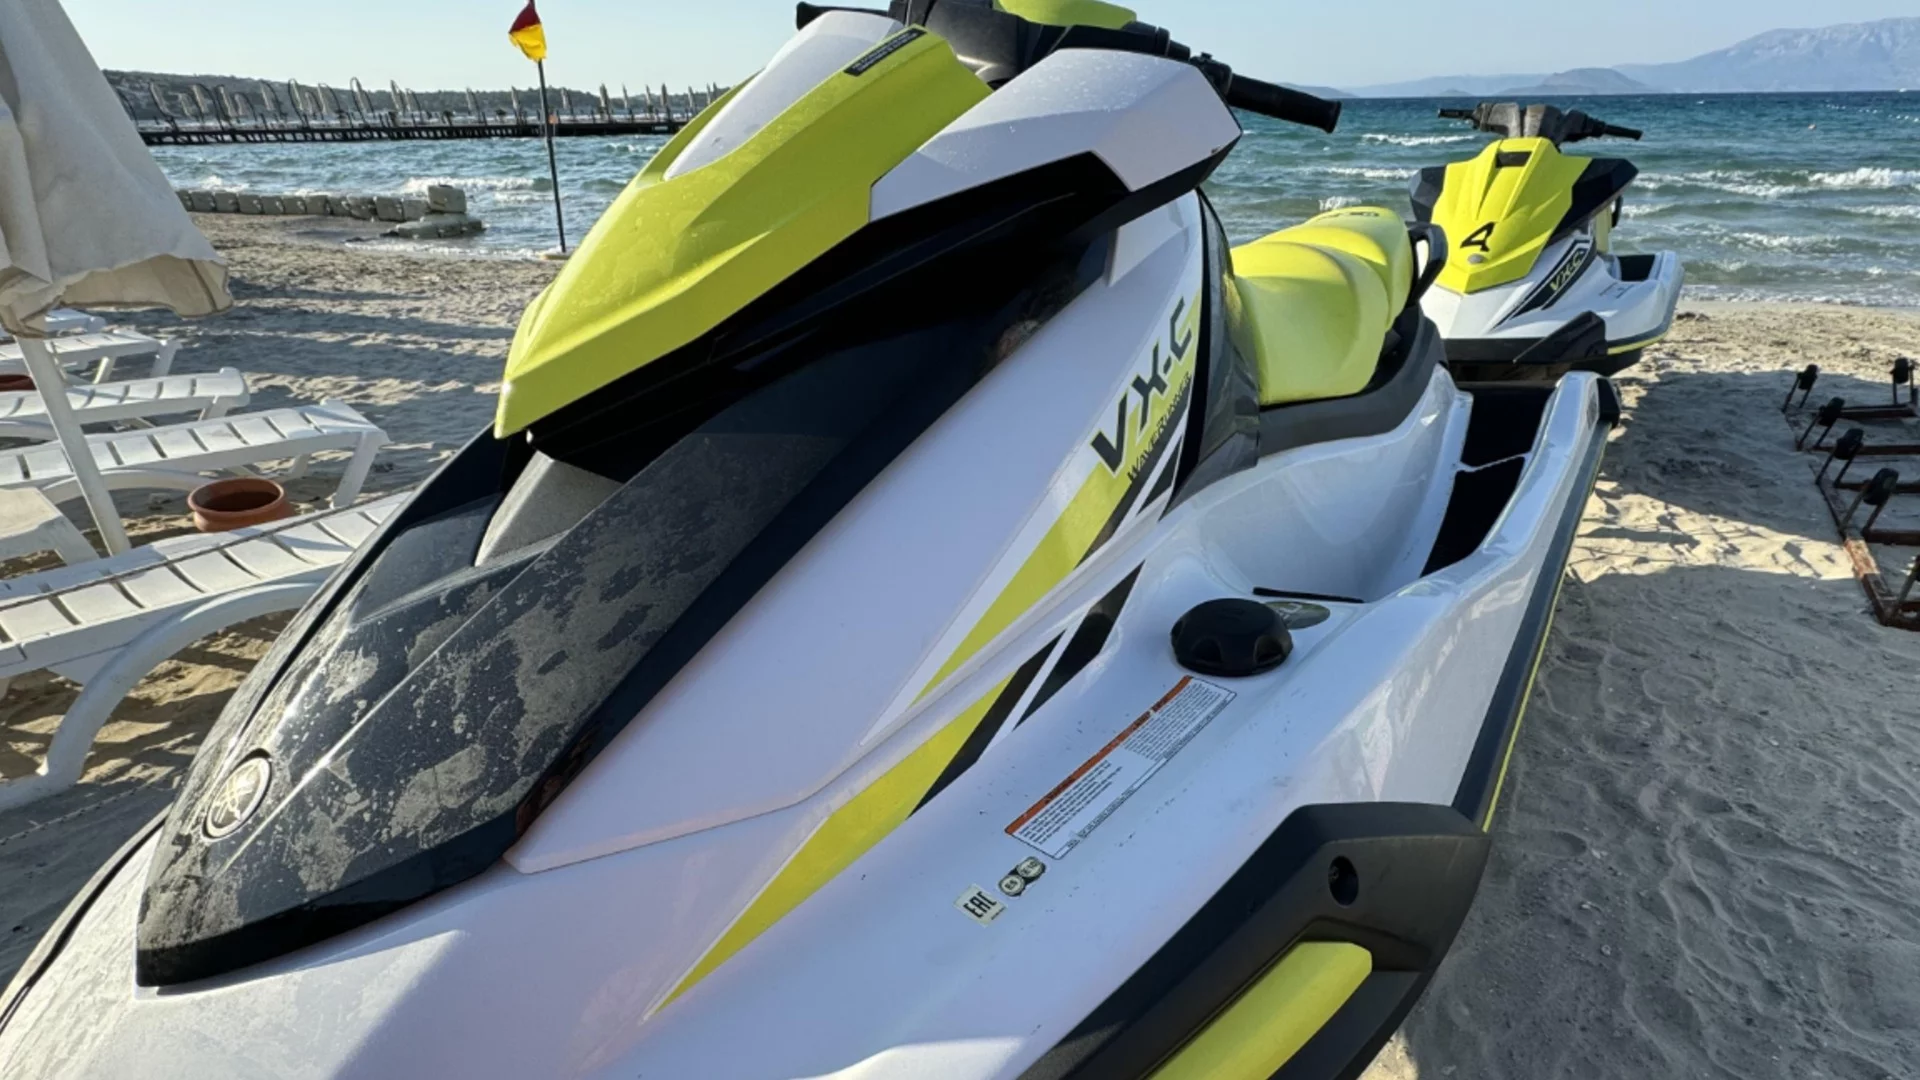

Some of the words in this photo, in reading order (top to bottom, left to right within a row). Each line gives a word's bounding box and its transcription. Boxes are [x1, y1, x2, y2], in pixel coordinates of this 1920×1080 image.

[1460, 222, 1497, 252] 4
[1549, 250, 1585, 291] VX-C
[1090, 296, 1193, 474] VX-C
[962, 890, 998, 919] EAC
